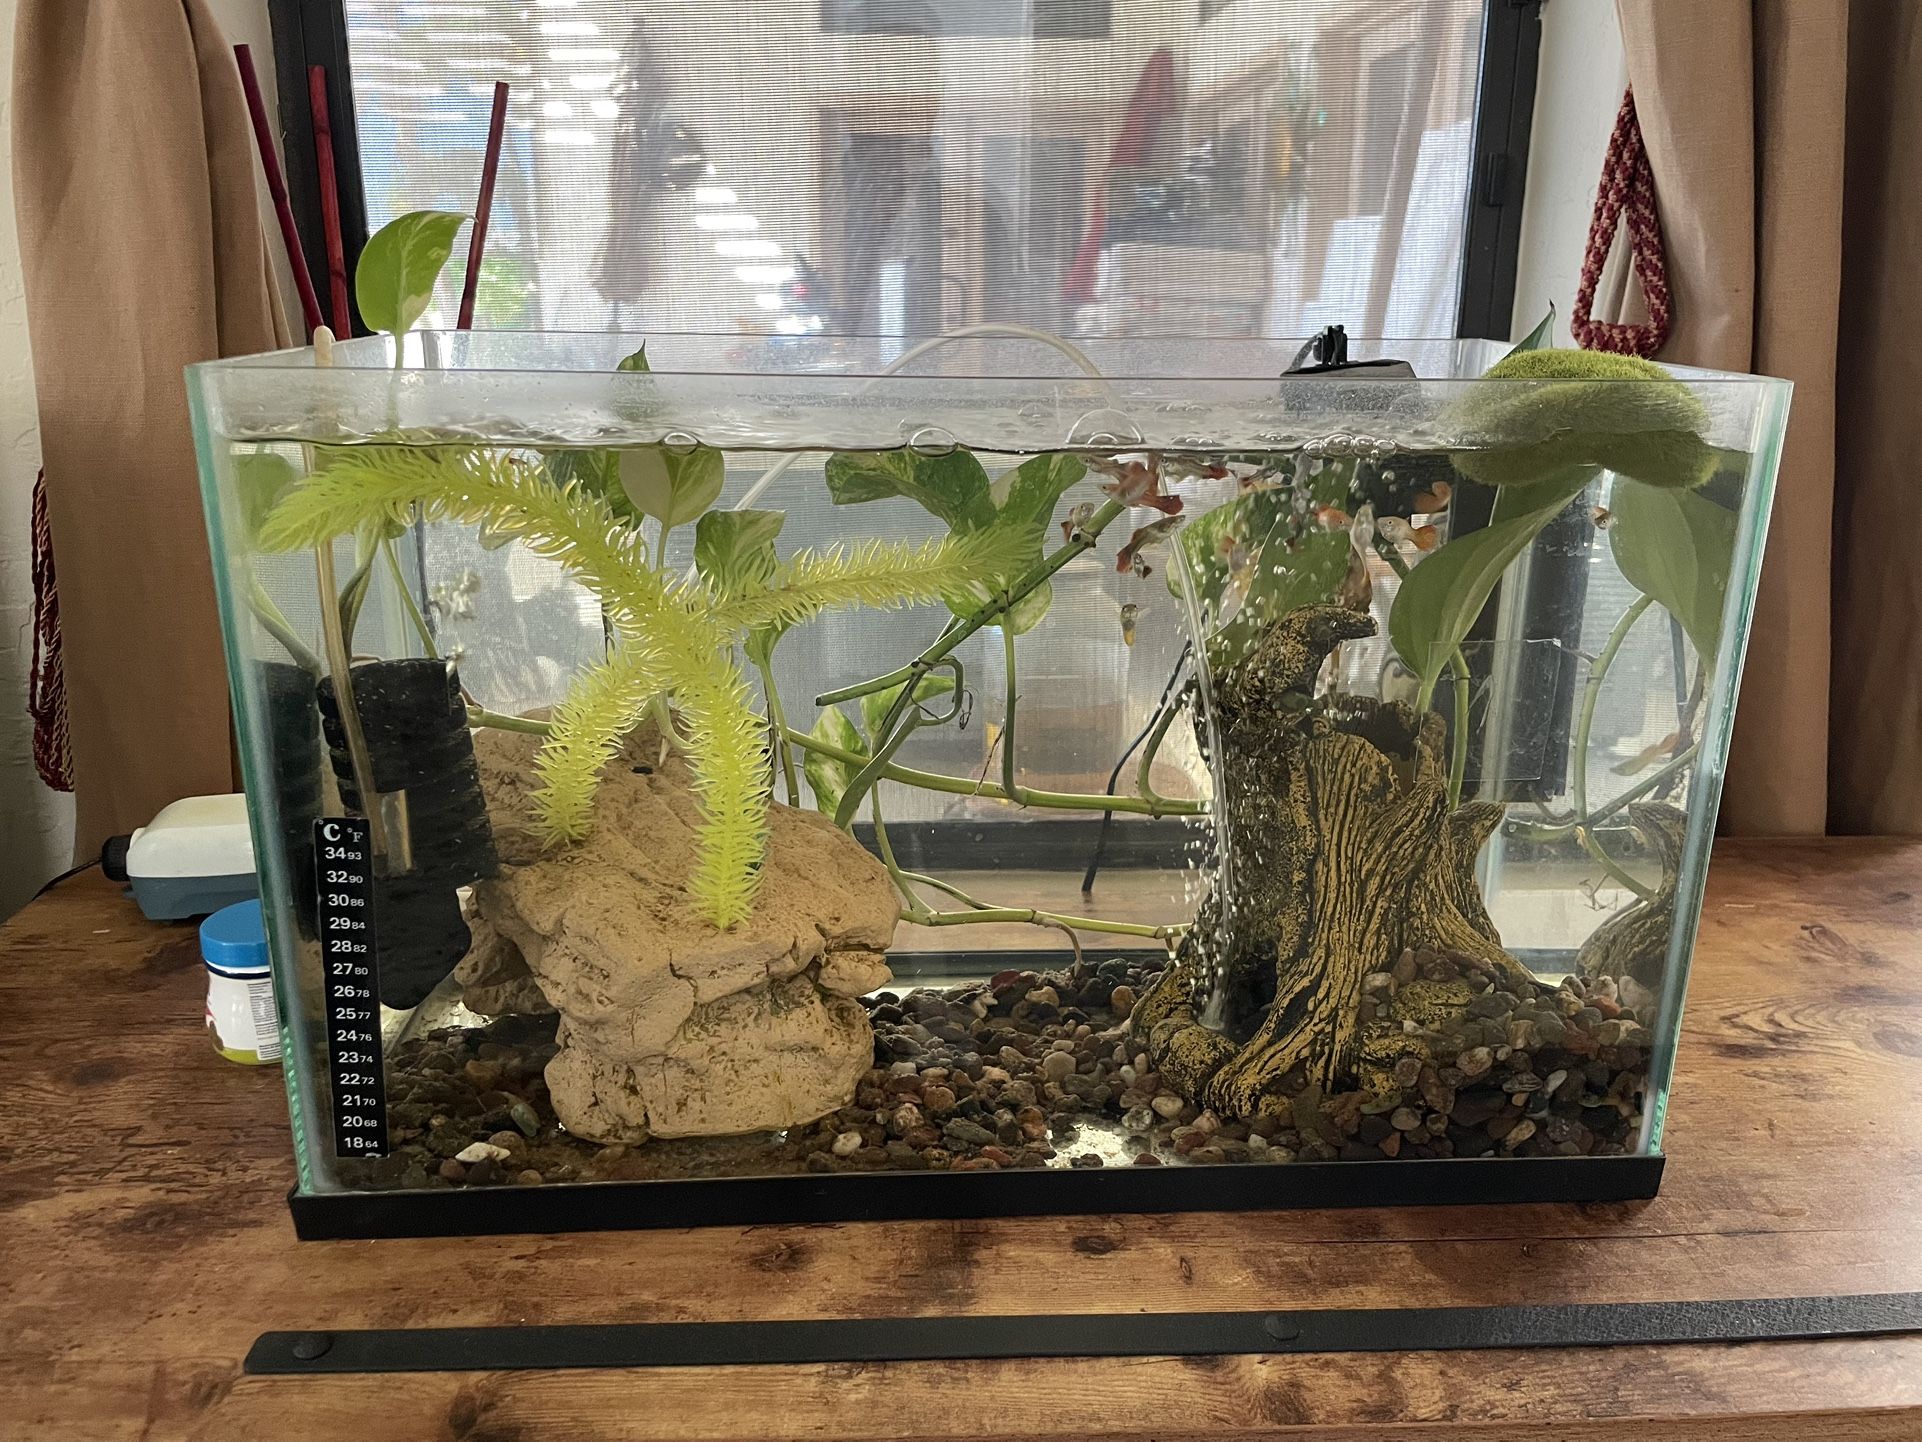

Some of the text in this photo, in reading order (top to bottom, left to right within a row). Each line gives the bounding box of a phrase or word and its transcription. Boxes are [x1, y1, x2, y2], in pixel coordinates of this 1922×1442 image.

[325, 847, 346, 859] 34
[327, 870, 348, 883] 32
[328, 894, 349, 906] 30
[329, 917, 351, 929] 29
[331, 940, 352, 952] 28
[332, 963, 353, 975] 27
[334, 985, 355, 997] 26
[335, 1007, 356, 1019] 25
[336, 1030, 357, 1041] 24
[338, 1051, 359, 1063] 23
[340, 1073, 360, 1085] 22
[342, 1094, 361, 1106] 21
[342, 1116, 363, 1127] 20
[344, 1137, 364, 1148] 18
